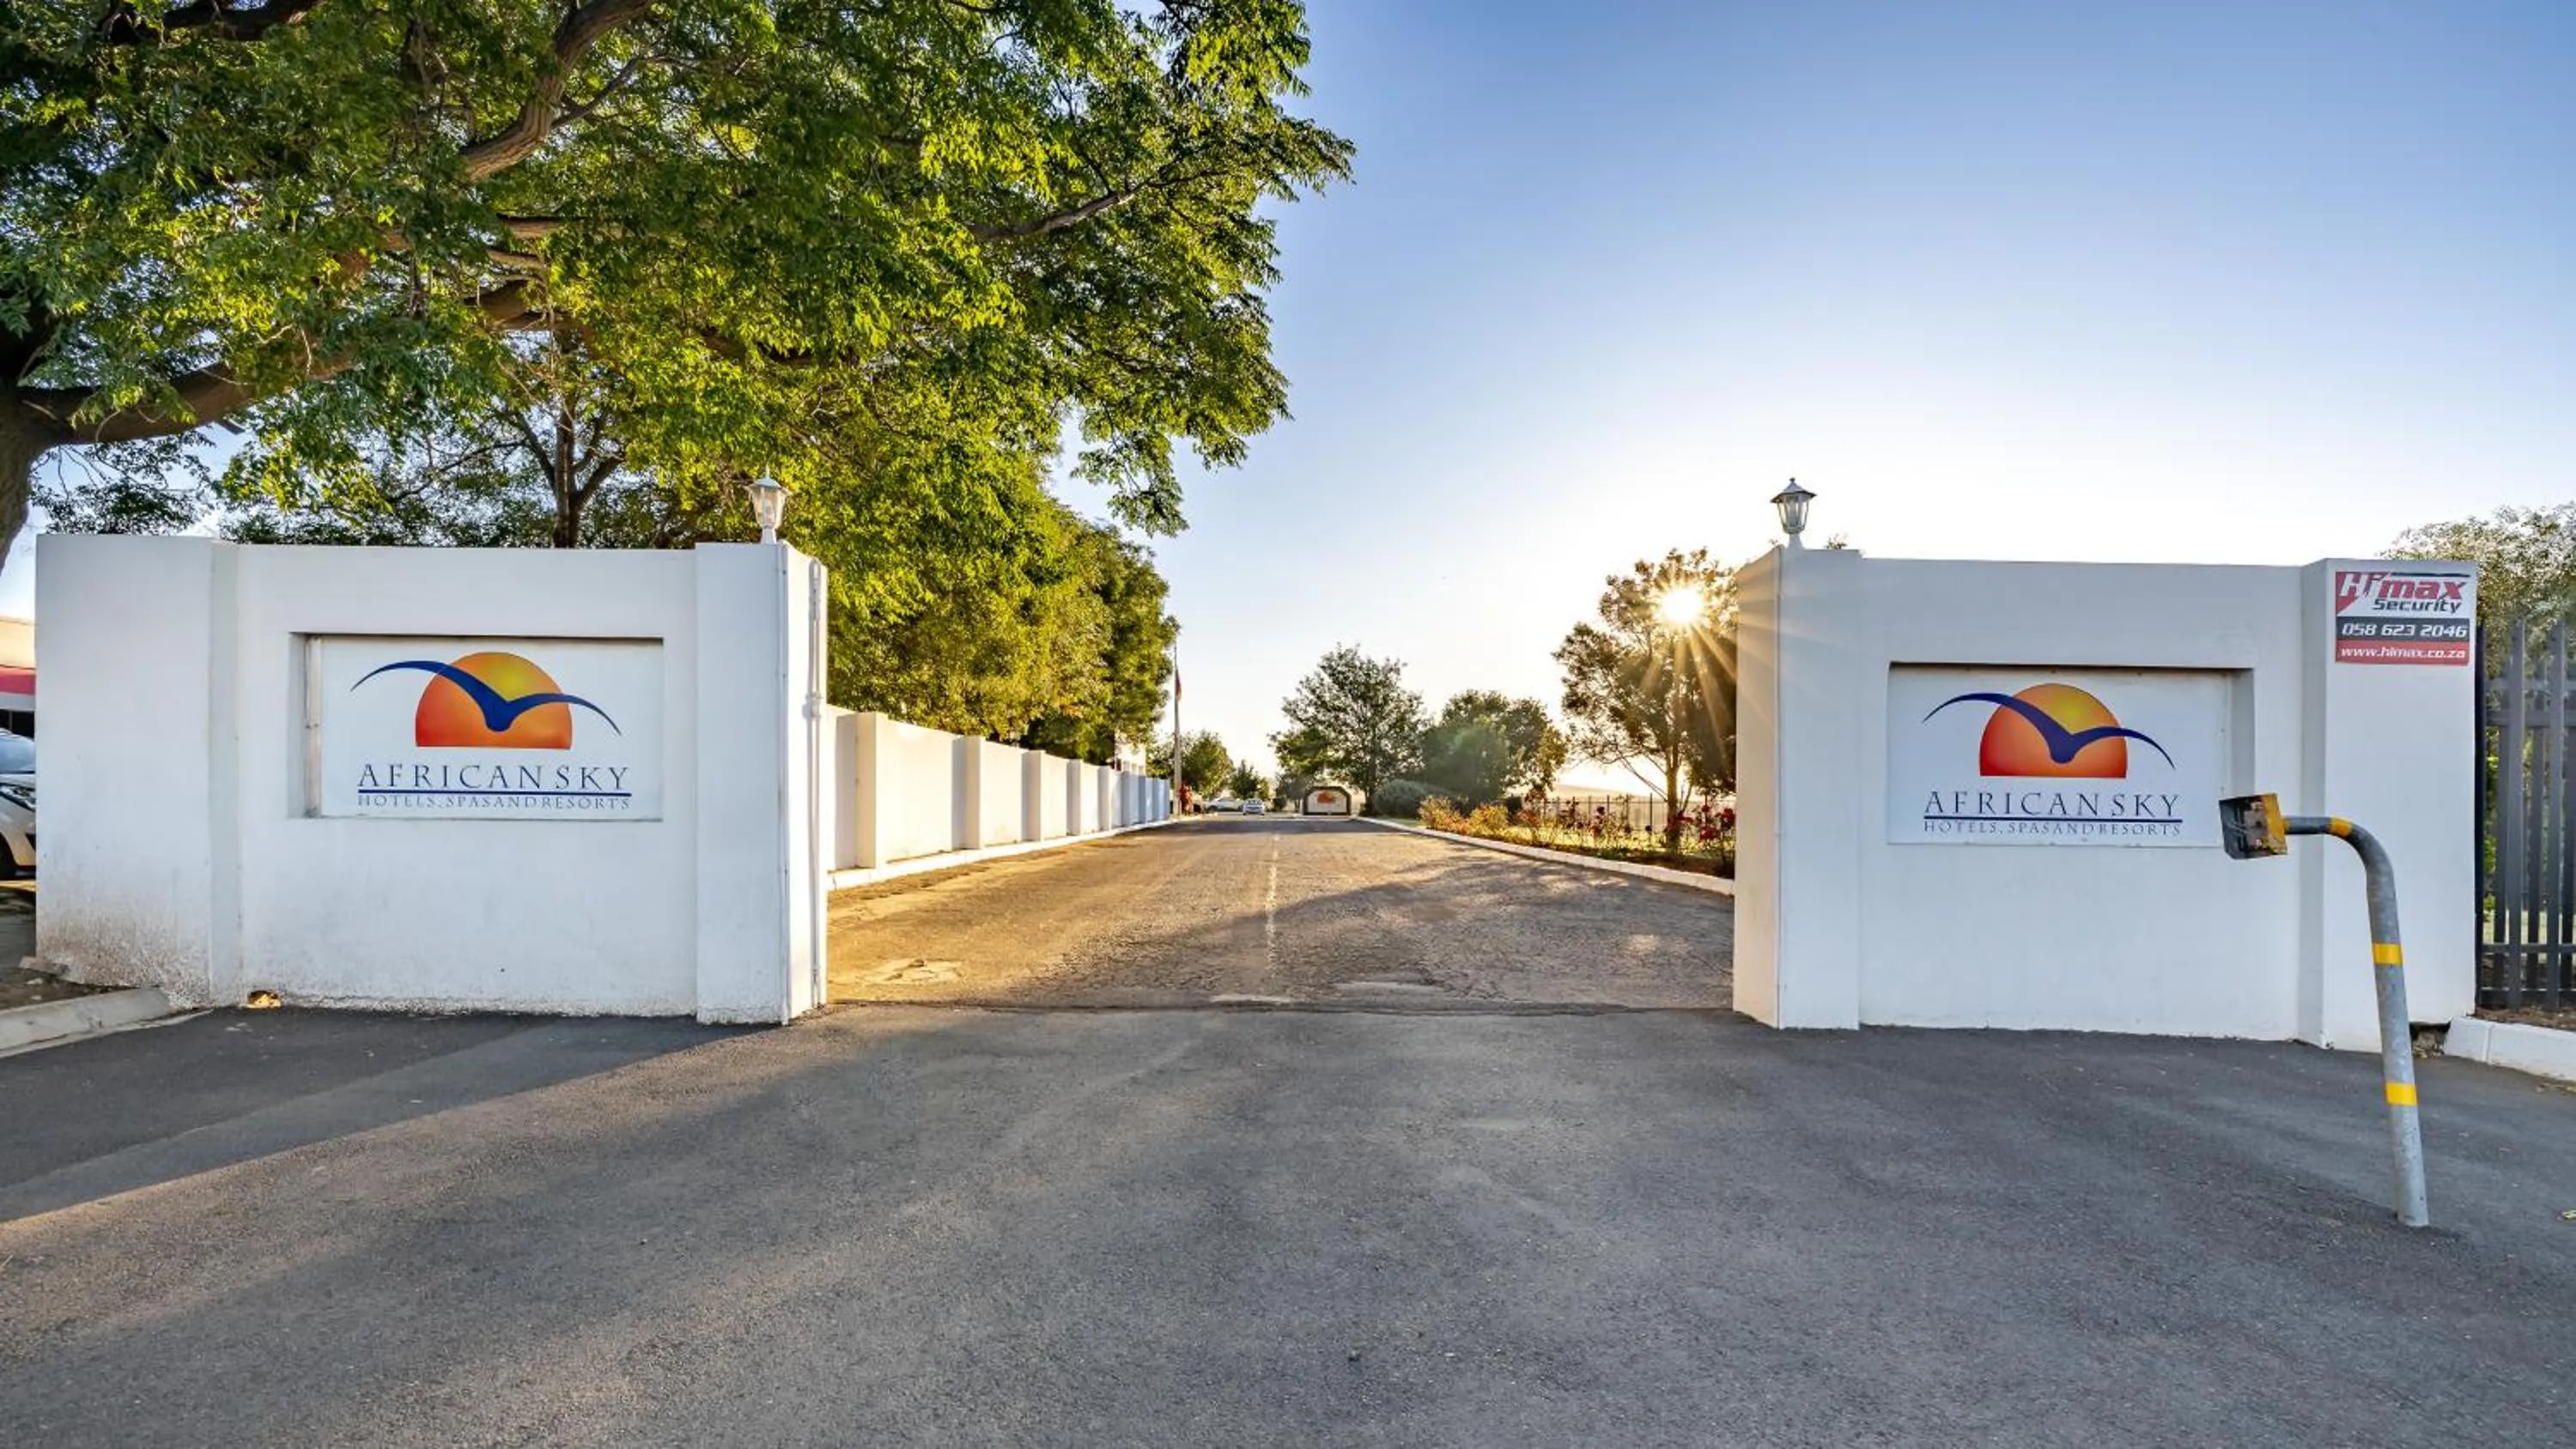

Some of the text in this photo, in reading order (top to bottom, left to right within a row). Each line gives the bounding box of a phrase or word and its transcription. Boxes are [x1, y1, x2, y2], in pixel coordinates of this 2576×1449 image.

[2372, 598, 2462, 614] Security
[2342, 622, 2467, 638] 058 623 2046
[2341, 646, 2466, 658] www.himax.co.za
